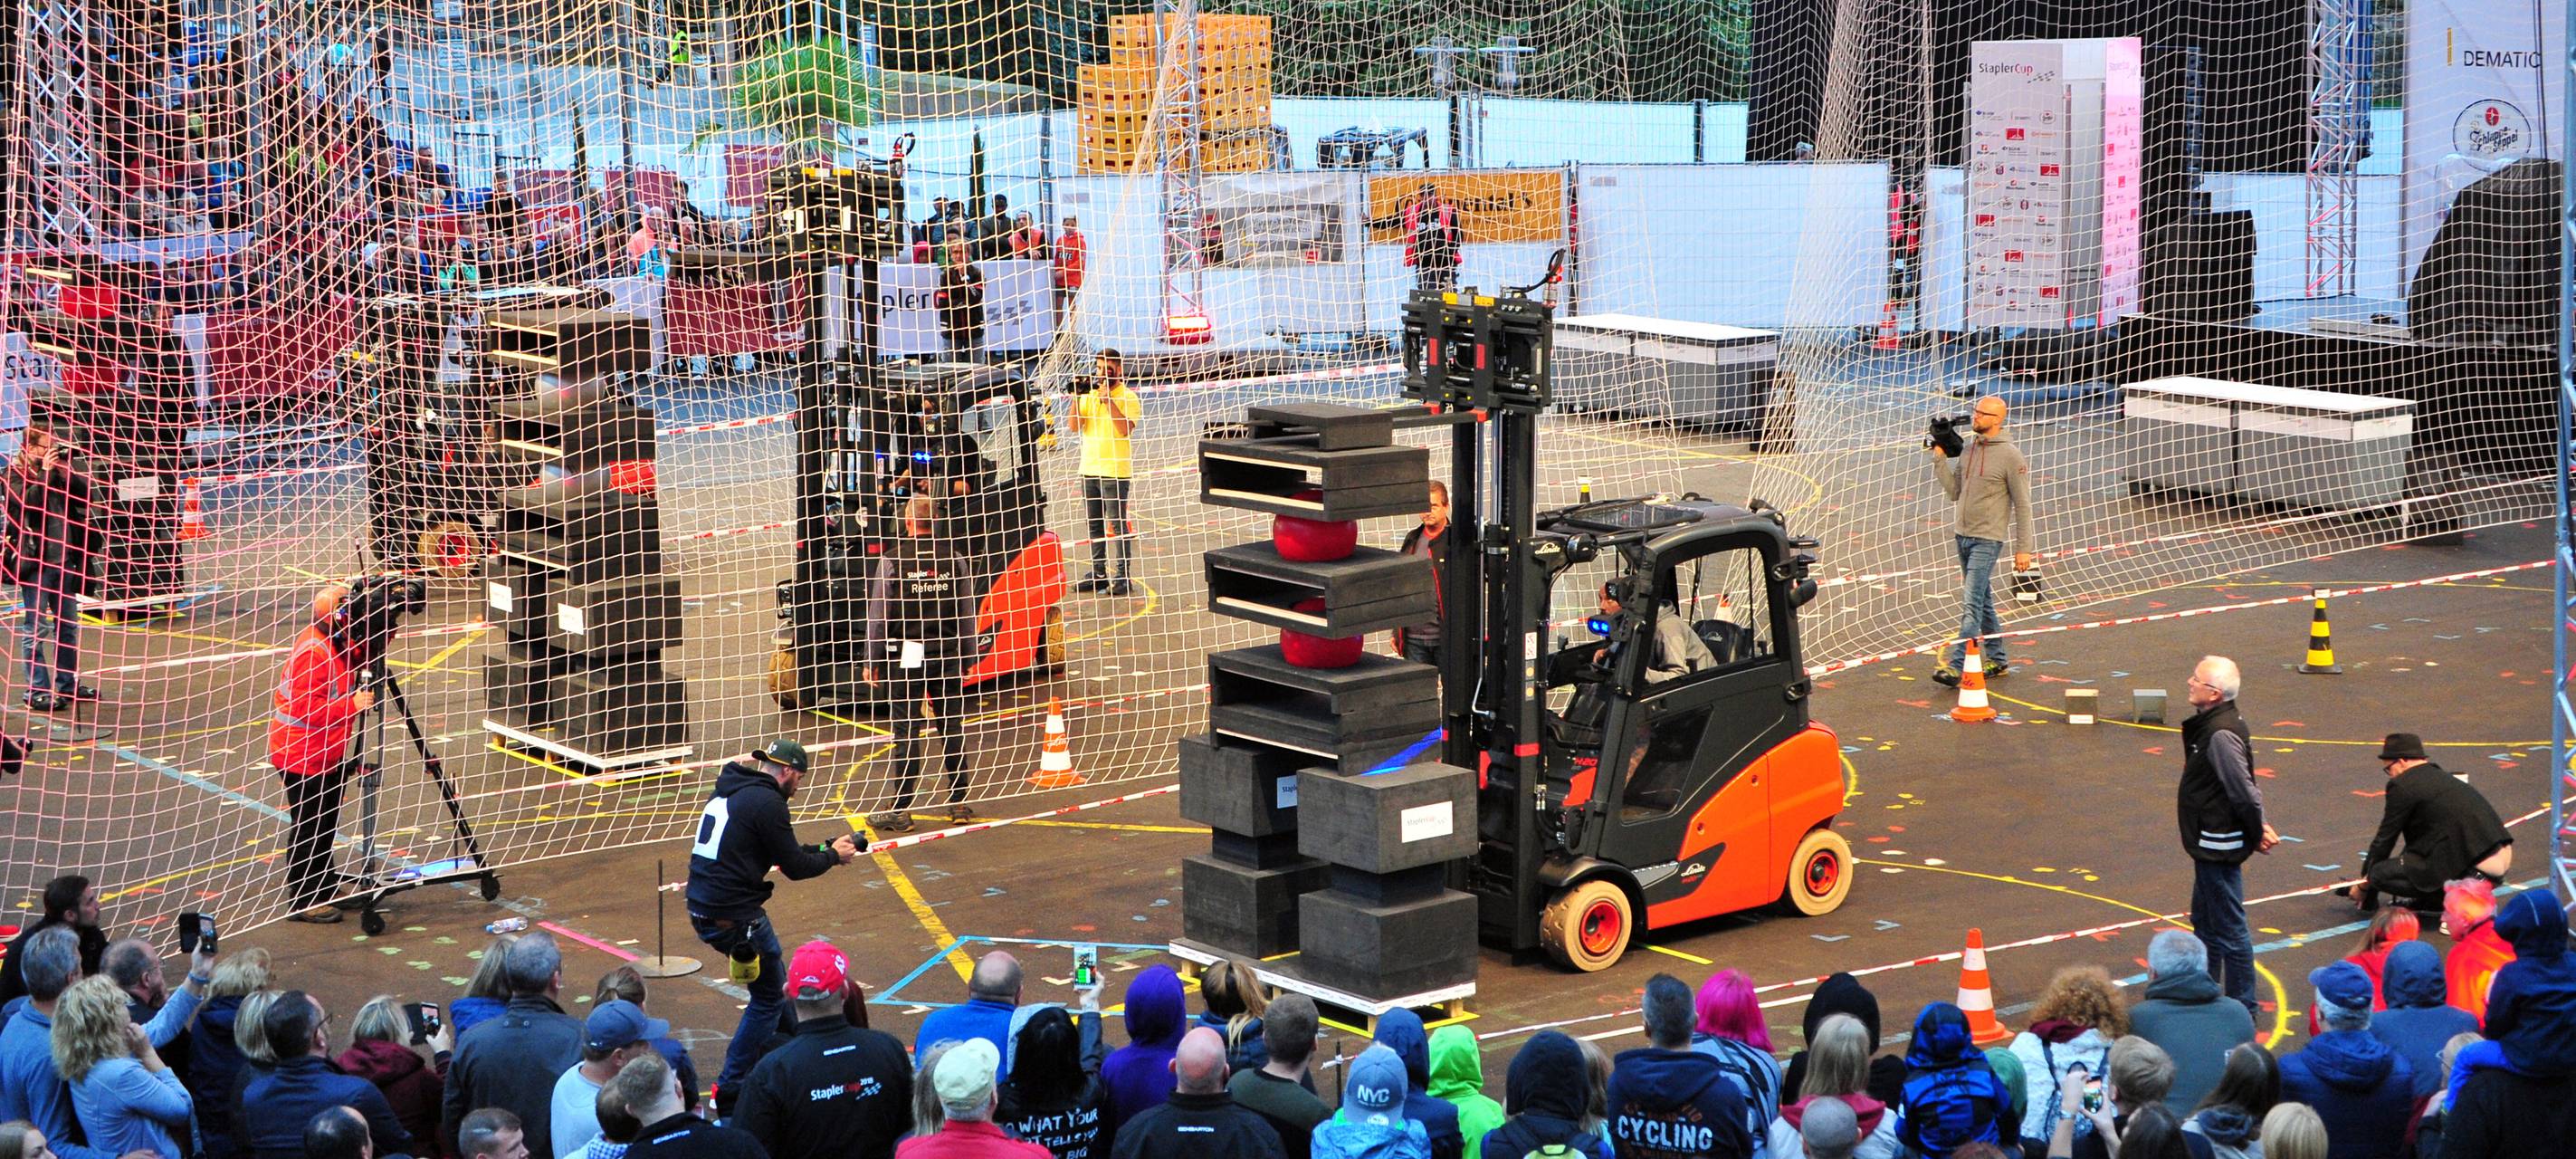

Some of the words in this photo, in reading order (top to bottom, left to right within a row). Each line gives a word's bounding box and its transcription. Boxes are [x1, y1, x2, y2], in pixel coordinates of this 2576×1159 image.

[2463, 50, 2542, 68] DEMATIC
[1979, 62, 2033, 76] StaplerCup
[911, 582, 949, 594] Referee
[1358, 1085, 1390, 1103] NYC
[1018, 1115, 1064, 1133] WHAT
[1617, 1115, 1713, 1151] CYCLING
